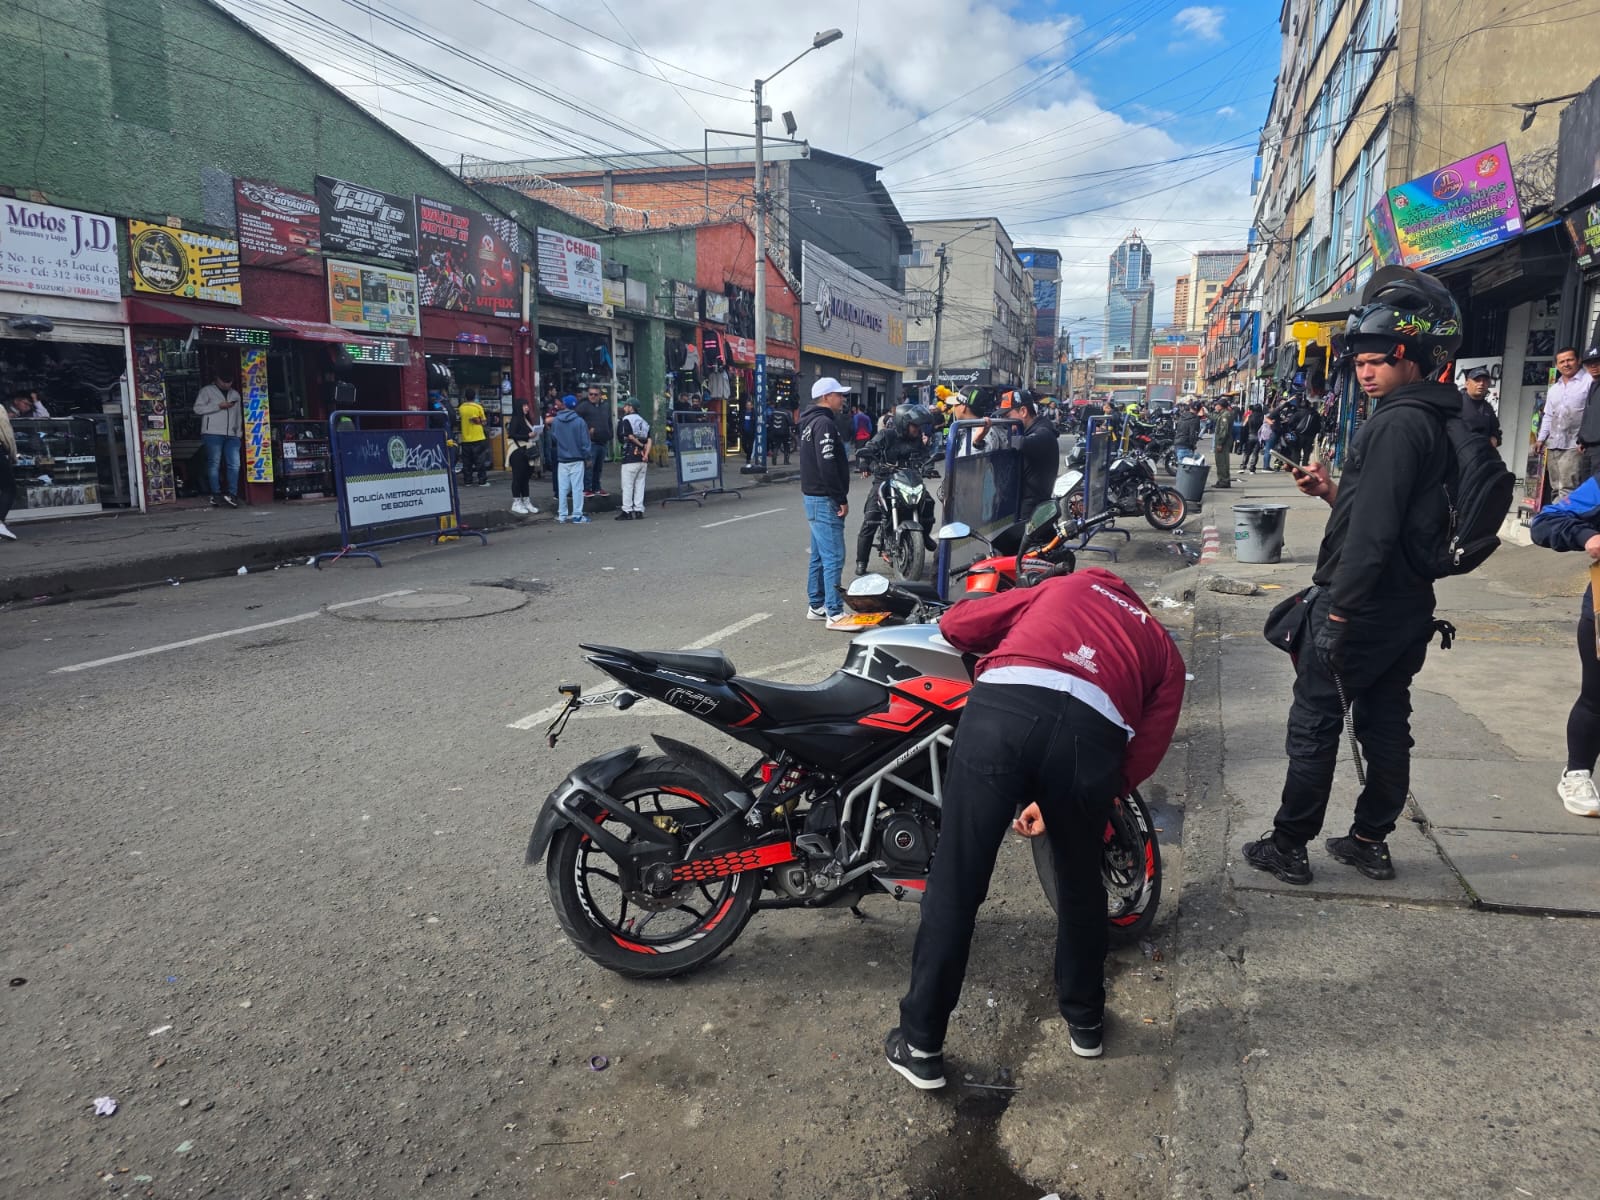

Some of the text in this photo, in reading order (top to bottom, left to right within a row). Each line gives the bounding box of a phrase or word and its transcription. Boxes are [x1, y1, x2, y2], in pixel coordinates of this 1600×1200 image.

[275, 196, 320, 214] BOYAQUITO
[1468, 203, 1499, 219] TANQUE
[261, 210, 300, 224] DEFENSAS
[1464, 208, 1507, 227] VISORES
[6, 204, 117, 259] Motos J.D.
[9, 226, 44, 239] Repuestos
[50, 233, 68, 243] Lujos
[7, 252, 27, 263] No.
[31, 255, 45, 266] 16
[55, 259, 69, 269] 45
[72, 261, 99, 273] Local
[52, 269, 71, 280] 312
[35, 283, 64, 293] SUZUKI
[246, 351, 266, 481] CALCOMANIAS
[352, 486, 446, 504] POLICÍA METROPOLITANA
[380, 499, 424, 512] DE BOGOTÁ
